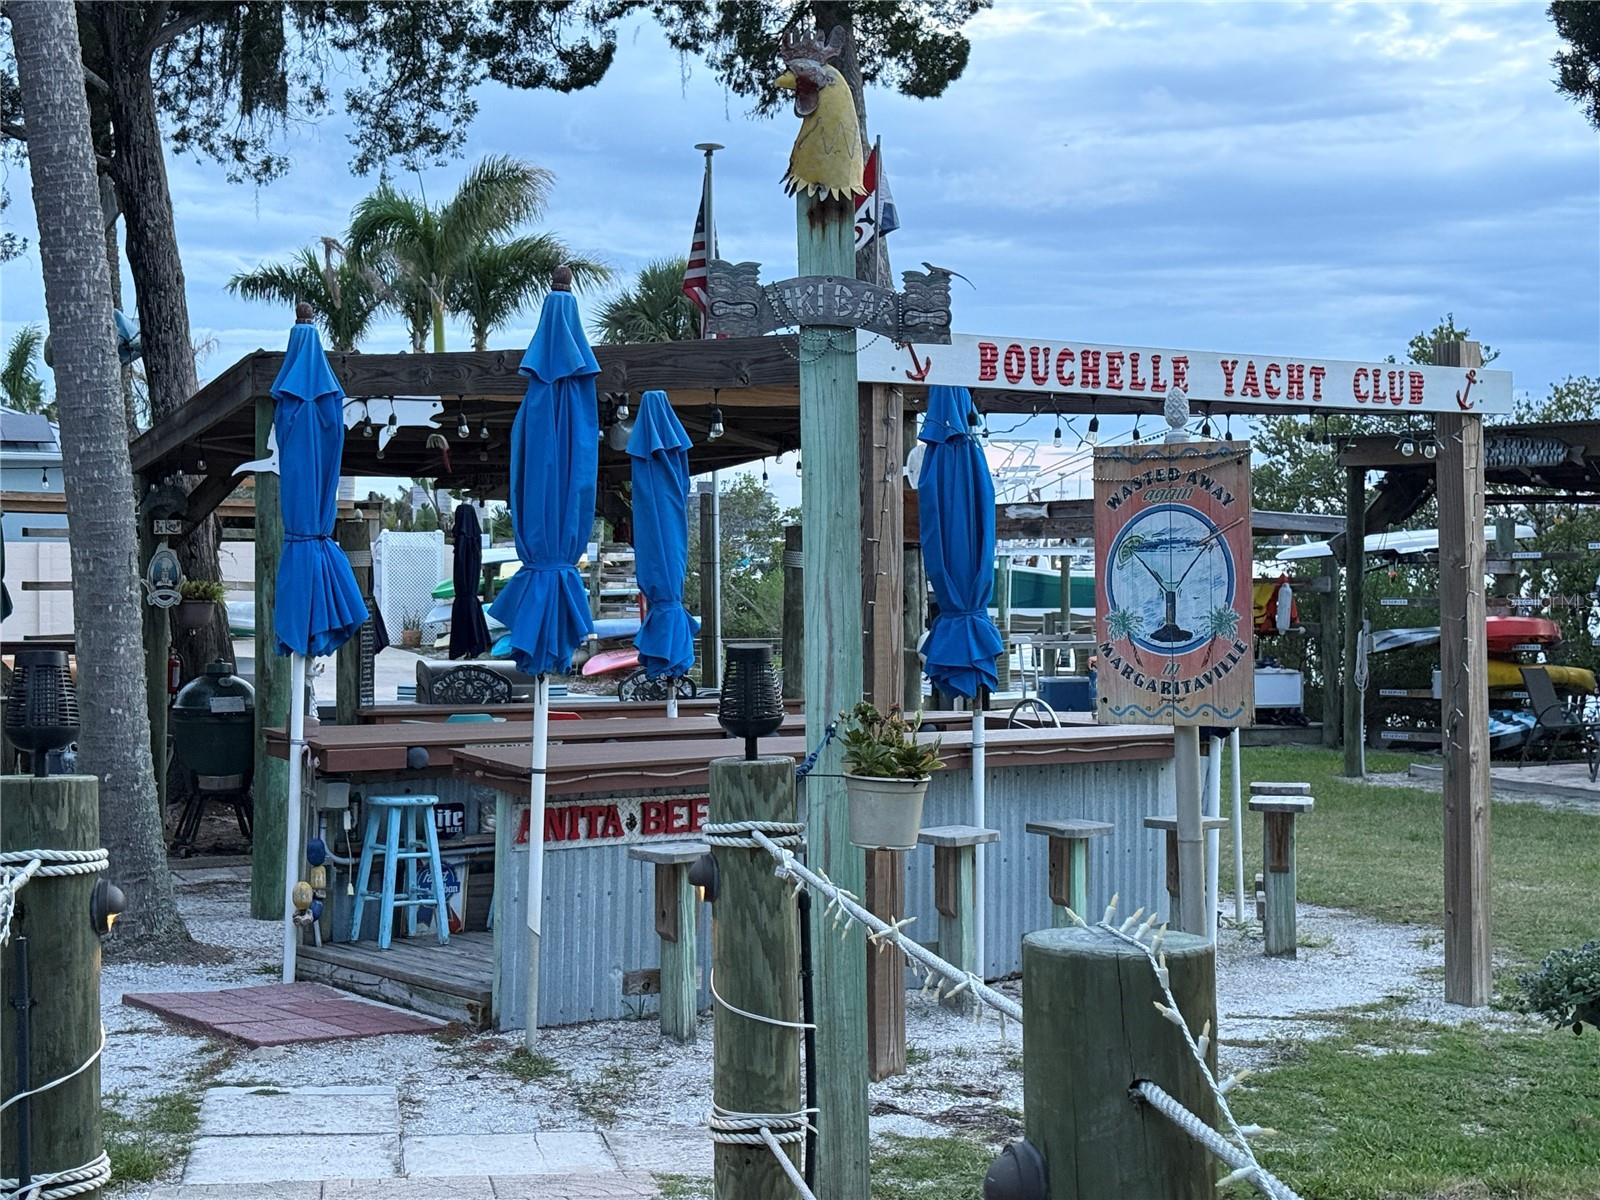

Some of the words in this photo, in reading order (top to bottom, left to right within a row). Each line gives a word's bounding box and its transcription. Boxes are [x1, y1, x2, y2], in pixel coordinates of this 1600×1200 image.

[834, 284, 895, 326] BAR
[978, 342, 1189, 393] BOUCHELLE
[1220, 360, 1326, 401] YACHT
[1353, 368, 1425, 405] CLUB
[1105, 467, 1182, 511] WASTED
[1186, 470, 1235, 509] AWAY
[1142, 486, 1194, 503] again
[1099, 640, 1248, 695] MARGARITAVILLE
[437, 809, 464, 827] ite
[641, 798, 710, 835] BEE
